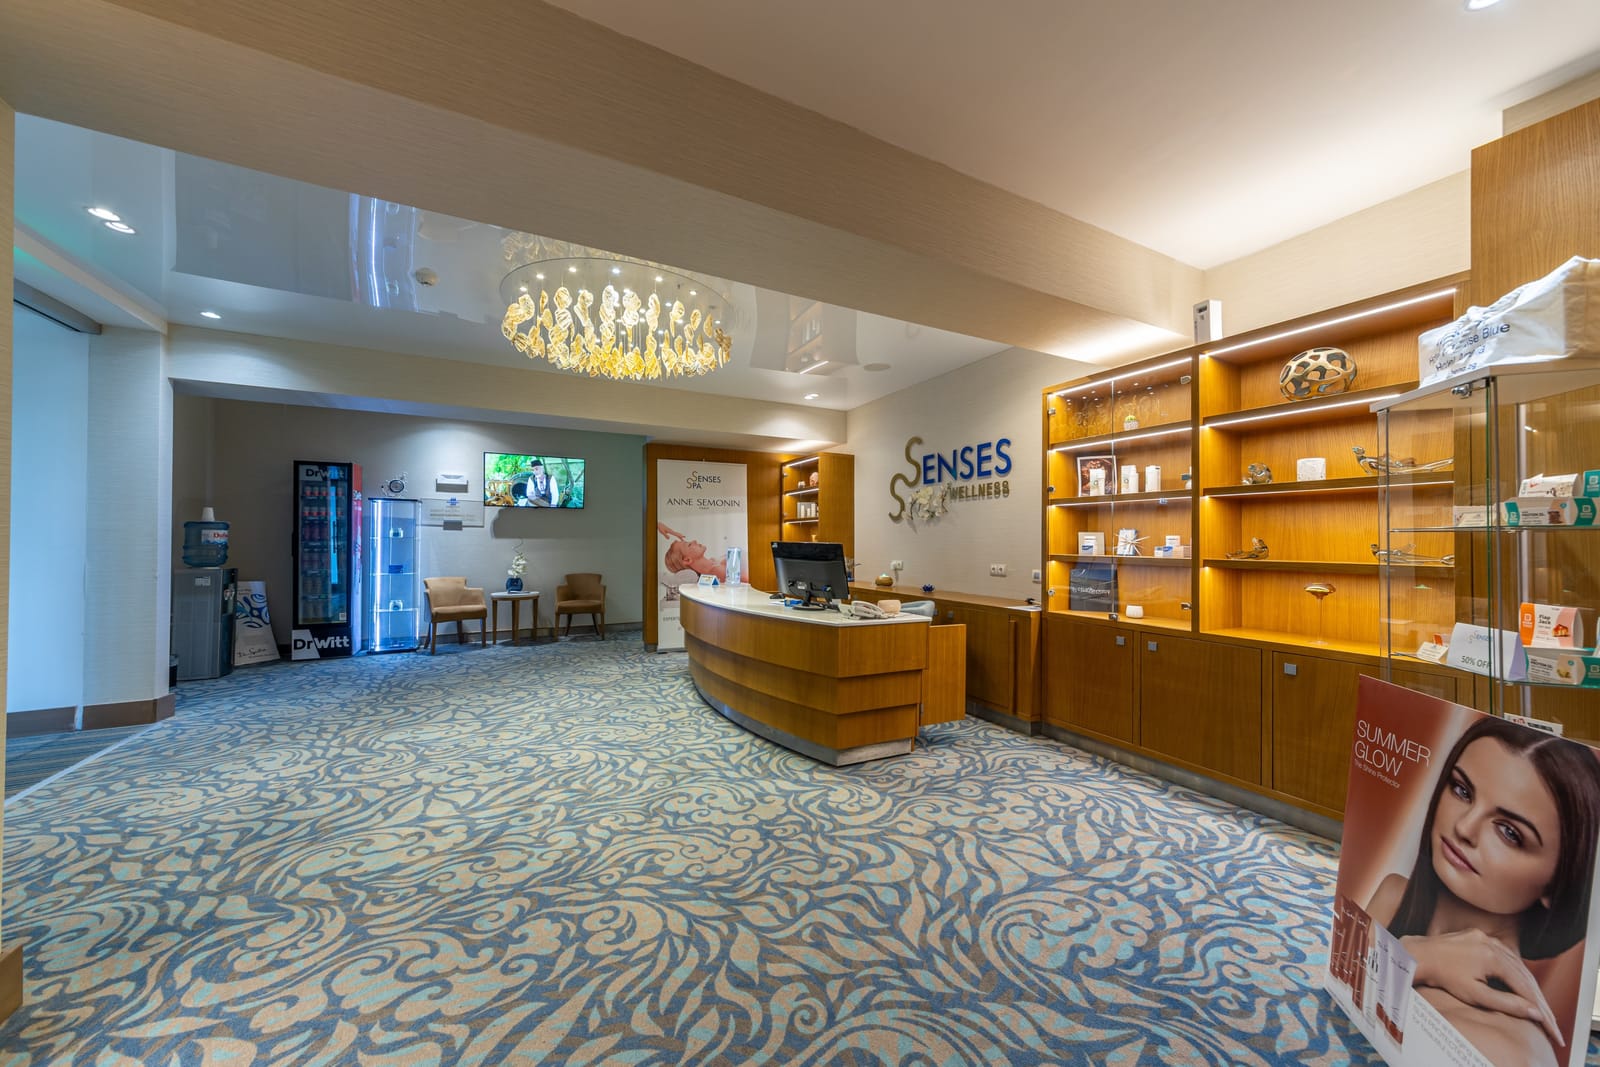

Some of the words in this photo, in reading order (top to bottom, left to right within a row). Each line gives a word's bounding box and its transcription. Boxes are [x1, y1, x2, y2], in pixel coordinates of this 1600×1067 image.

[1482, 323, 1511, 339] Blue
[905, 436, 1012, 488] SENSES
[686, 477, 702, 489] SPA
[692, 471, 721, 484] SENSES
[949, 481, 1010, 500] WELLNESS
[667, 498, 694, 506] ANNE
[696, 498, 740, 507] SEMONIN
[294, 635, 350, 650] DrWitt
[1461, 655, 1476, 666] 50%
[1476, 659, 1492, 669] OFF
[1356, 719, 1431, 768] SUMMER
[1354, 740, 1403, 777] GLOW
[1377, 771, 1401, 789] Protector
